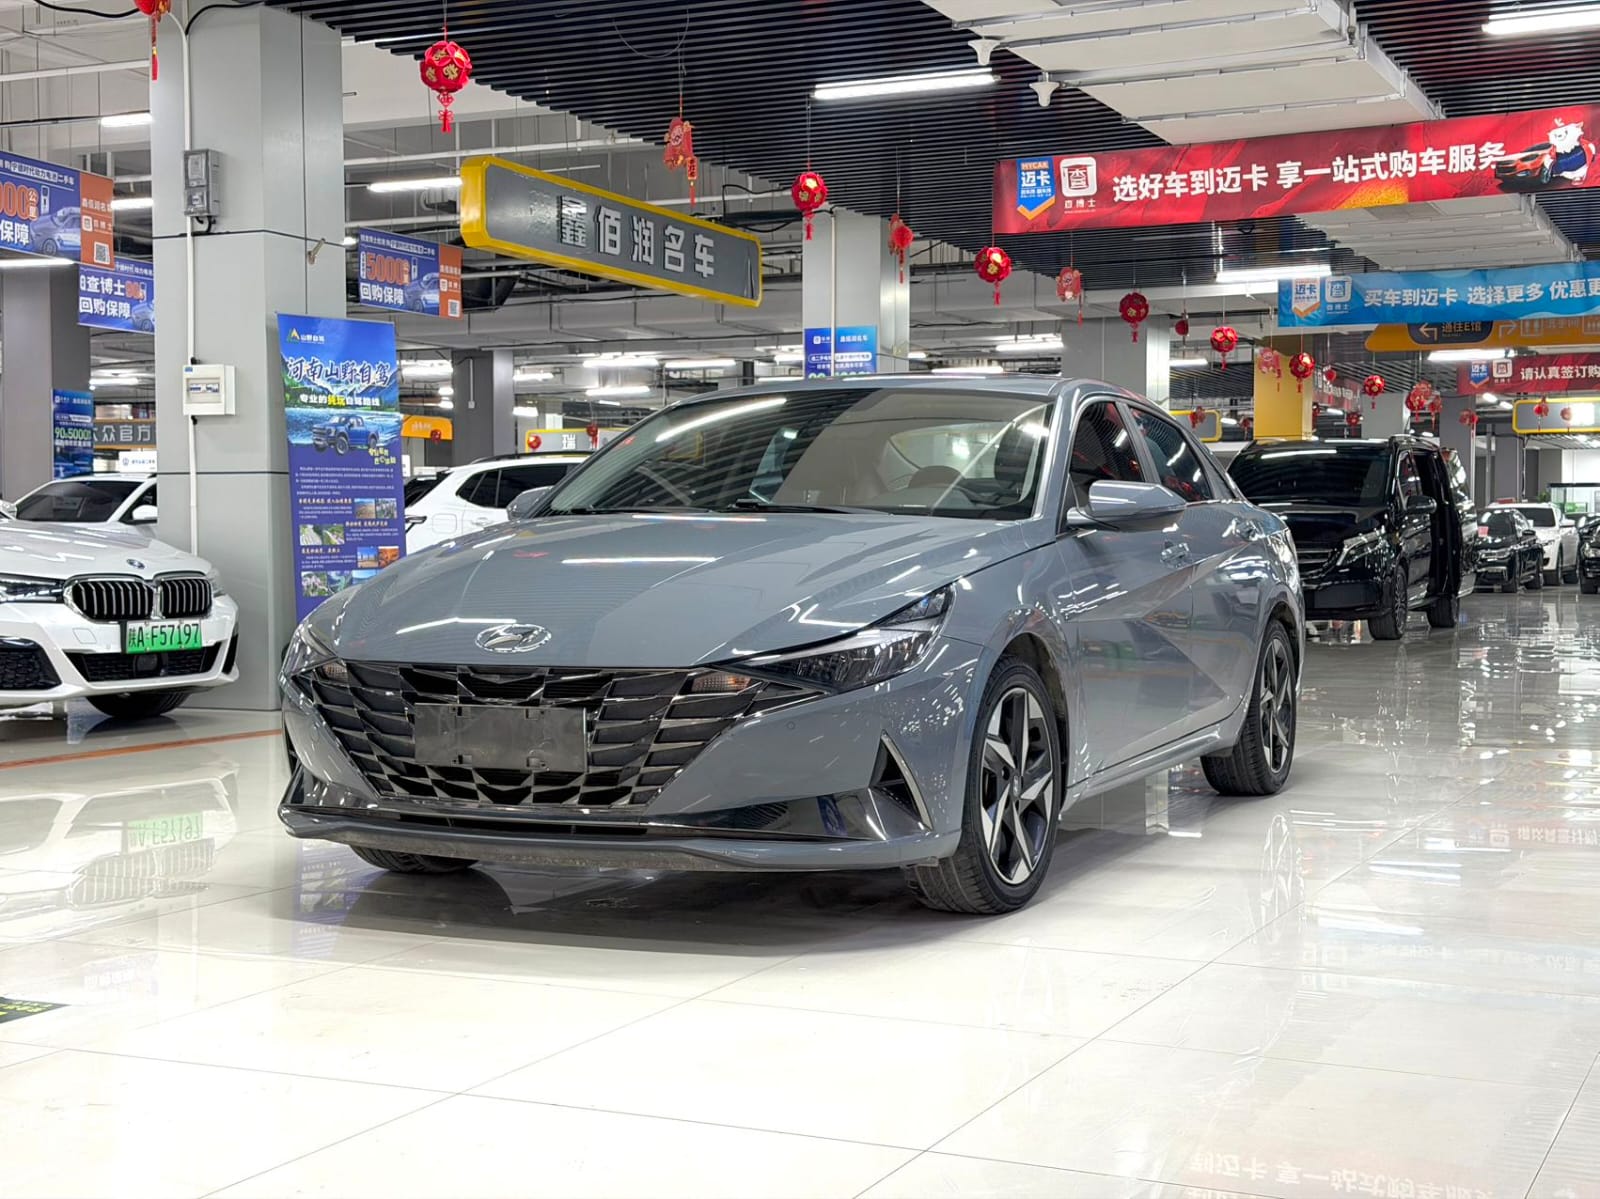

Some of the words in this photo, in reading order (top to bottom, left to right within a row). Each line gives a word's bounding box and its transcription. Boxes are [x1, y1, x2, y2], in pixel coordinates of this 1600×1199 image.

[1021, 170, 1051, 187] 迈卡
[1112, 163, 1270, 202] 选好车到迈卡
[1274, 141, 1505, 189] 享一站式购车服务
[1065, 198, 1096, 209] 查博士
[0, 219, 29, 246] 保障
[557, 195, 714, 278] 鑫佰润名车
[87, 276, 125, 296] 查博士
[360, 283, 404, 305] 回购保障
[1295, 284, 1317, 295] 迈卡
[1363, 288, 1459, 307] 买车到迈卡
[1468, 282, 1545, 305] 选择更多
[79, 296, 131, 319] 回购保障
[286, 356, 391, 387] 河南山野自驾
[1519, 364, 1600, 381] 请认真签订购
